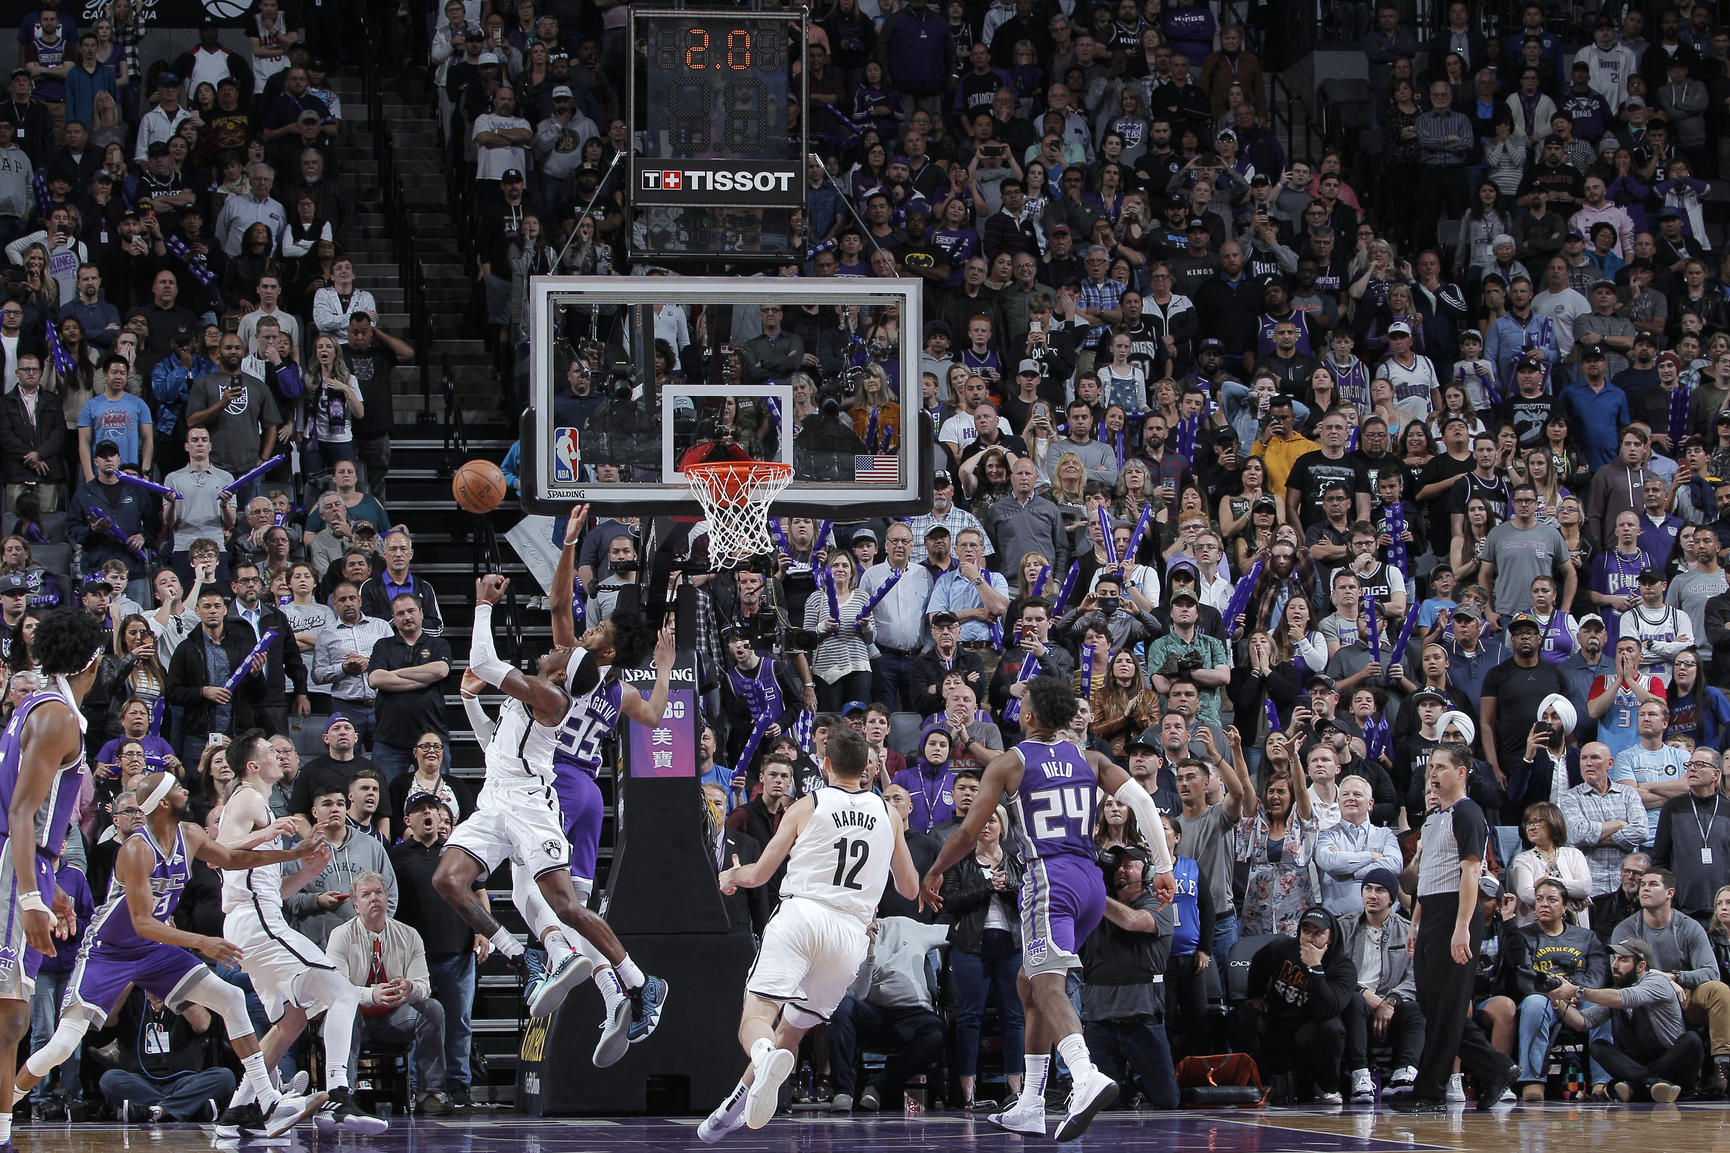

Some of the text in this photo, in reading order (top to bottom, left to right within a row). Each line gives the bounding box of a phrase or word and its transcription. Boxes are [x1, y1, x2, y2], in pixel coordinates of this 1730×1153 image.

[685, 28, 751, 71] 2.0
[684, 170, 796, 192] TISSOT
[557, 469, 571, 480] NBA
[547, 489, 585, 499] SPALDING
[1361, 585, 1389, 597] NGS
[1607, 573, 1641, 595] KING
[288, 614, 327, 632] Kings
[1618, 708, 1631, 728] 3
[558, 714, 610, 762] 35
[1040, 761, 1073, 779] HIELD
[831, 810, 877, 832] HARRIS
[1030, 786, 1091, 840] 24
[832, 837, 870, 892] 12
[1174, 878, 1197, 897] KE
[1027, 945, 1047, 959] SAC
[1535, 946, 1582, 960] NORTHERN
[1230, 960, 1252, 968] CACH
